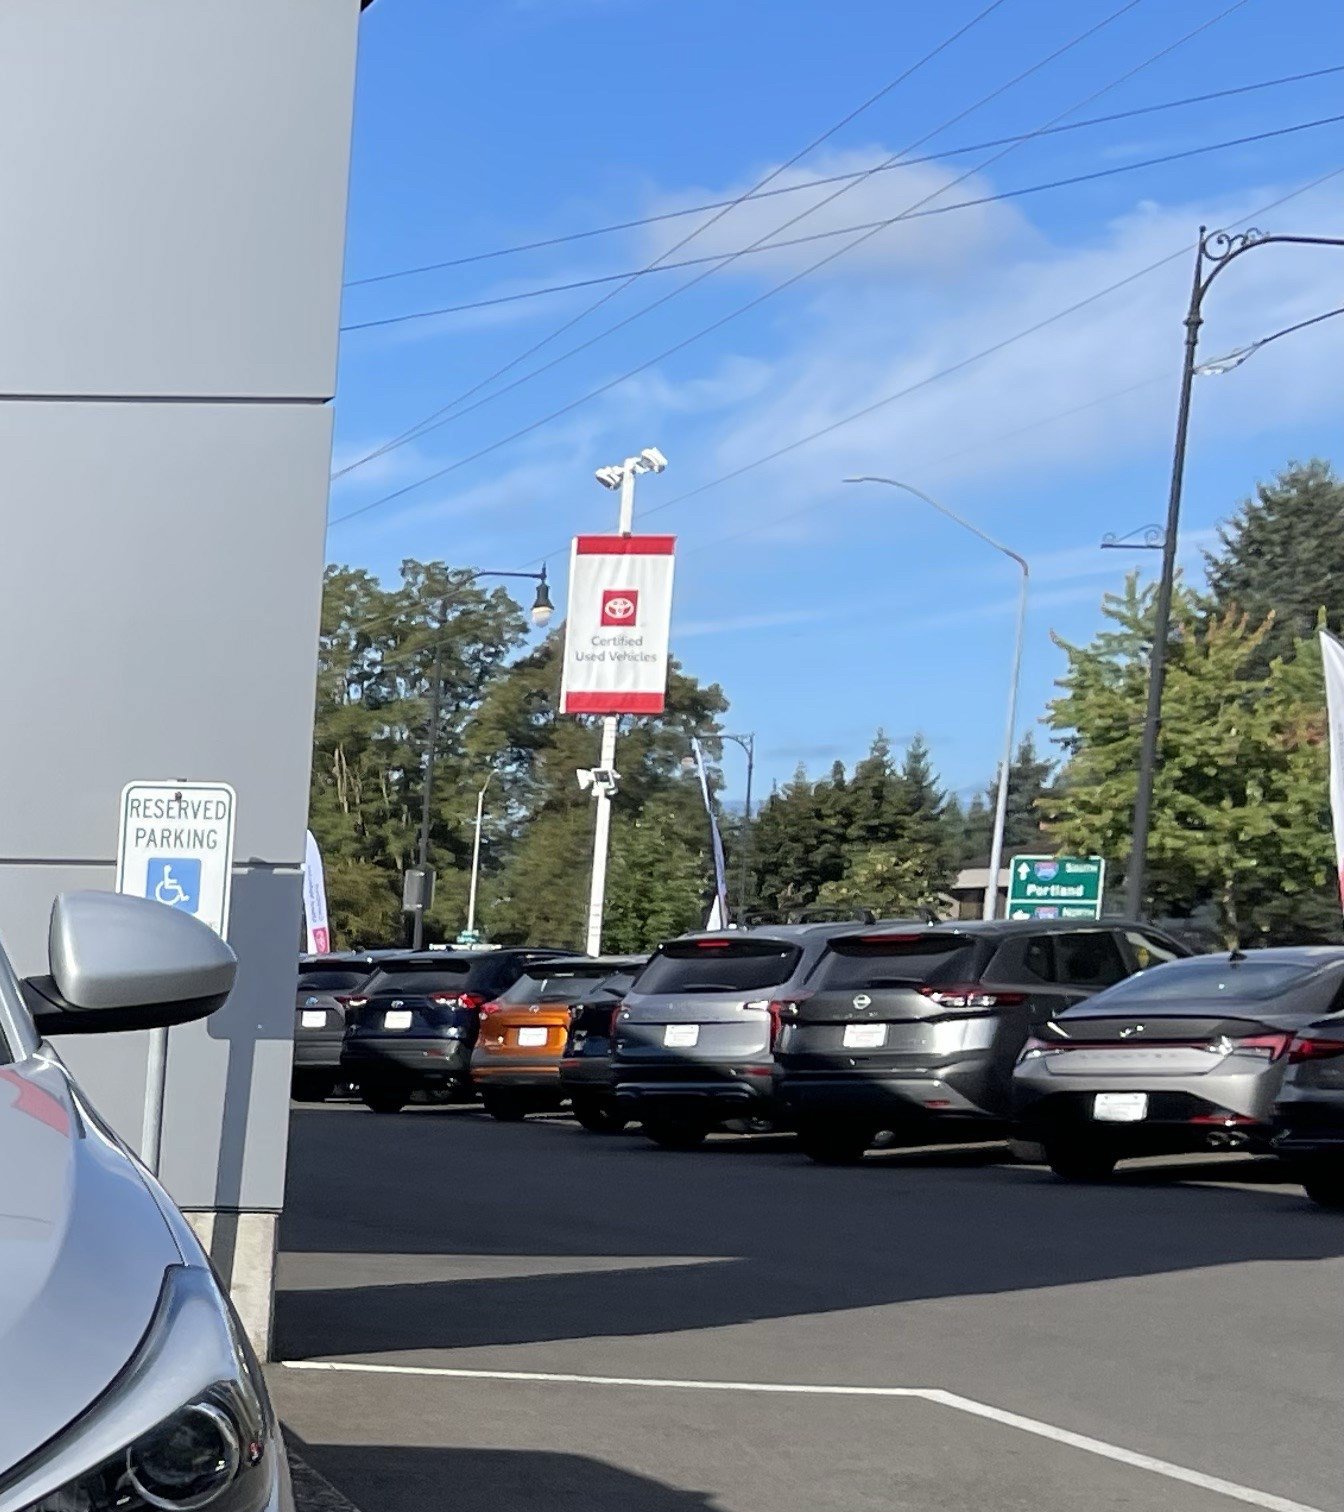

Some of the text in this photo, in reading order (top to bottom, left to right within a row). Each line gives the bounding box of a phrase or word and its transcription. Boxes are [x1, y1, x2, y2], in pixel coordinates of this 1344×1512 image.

[591, 635, 643, 647] Certified
[575, 650, 657, 663] Used Vehicles
[130, 798, 227, 820] RESERVED
[135, 828, 218, 850] PARKING
[1026, 884, 1084, 897] Portland
